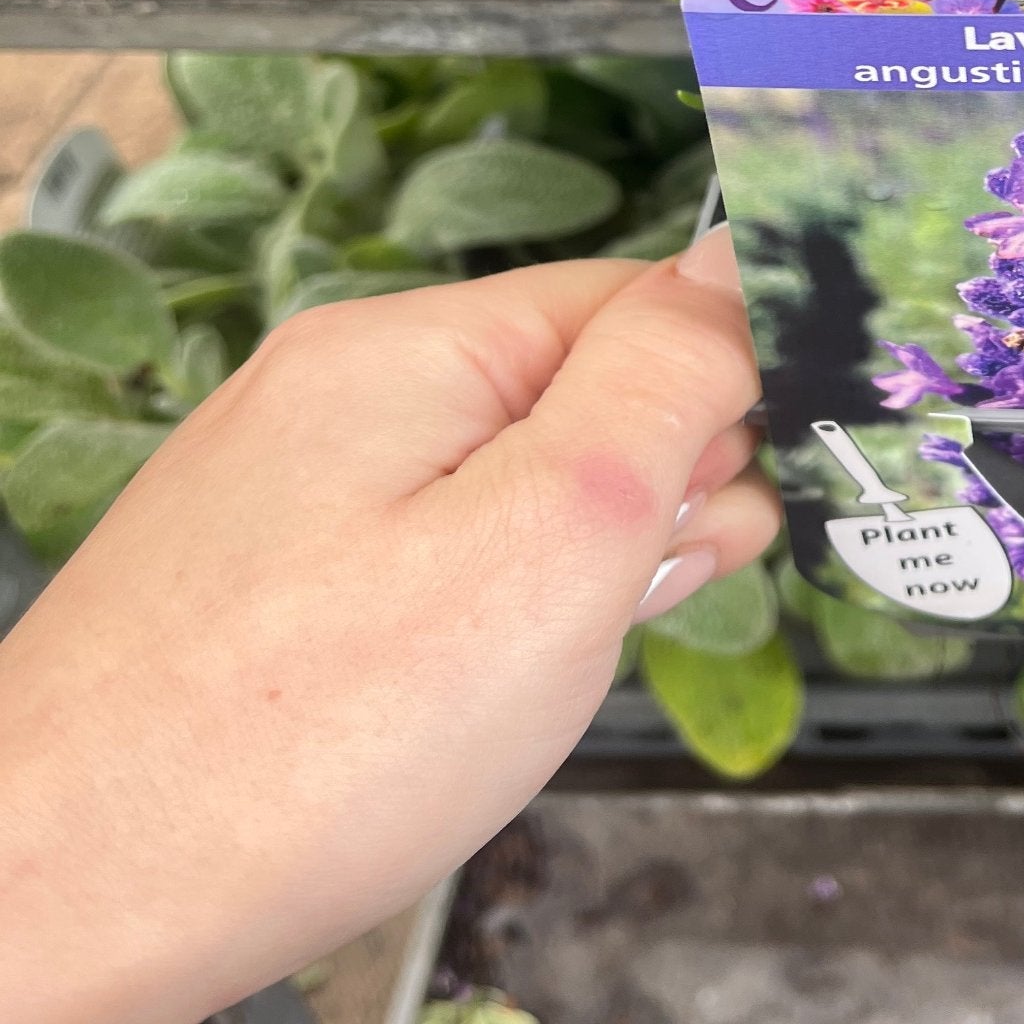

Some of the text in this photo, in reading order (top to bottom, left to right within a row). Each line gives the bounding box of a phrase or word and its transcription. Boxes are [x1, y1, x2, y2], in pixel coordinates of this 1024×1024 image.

[860, 521, 958, 546] Plant
[900, 552, 953, 569] me
[906, 577, 980, 597] now
